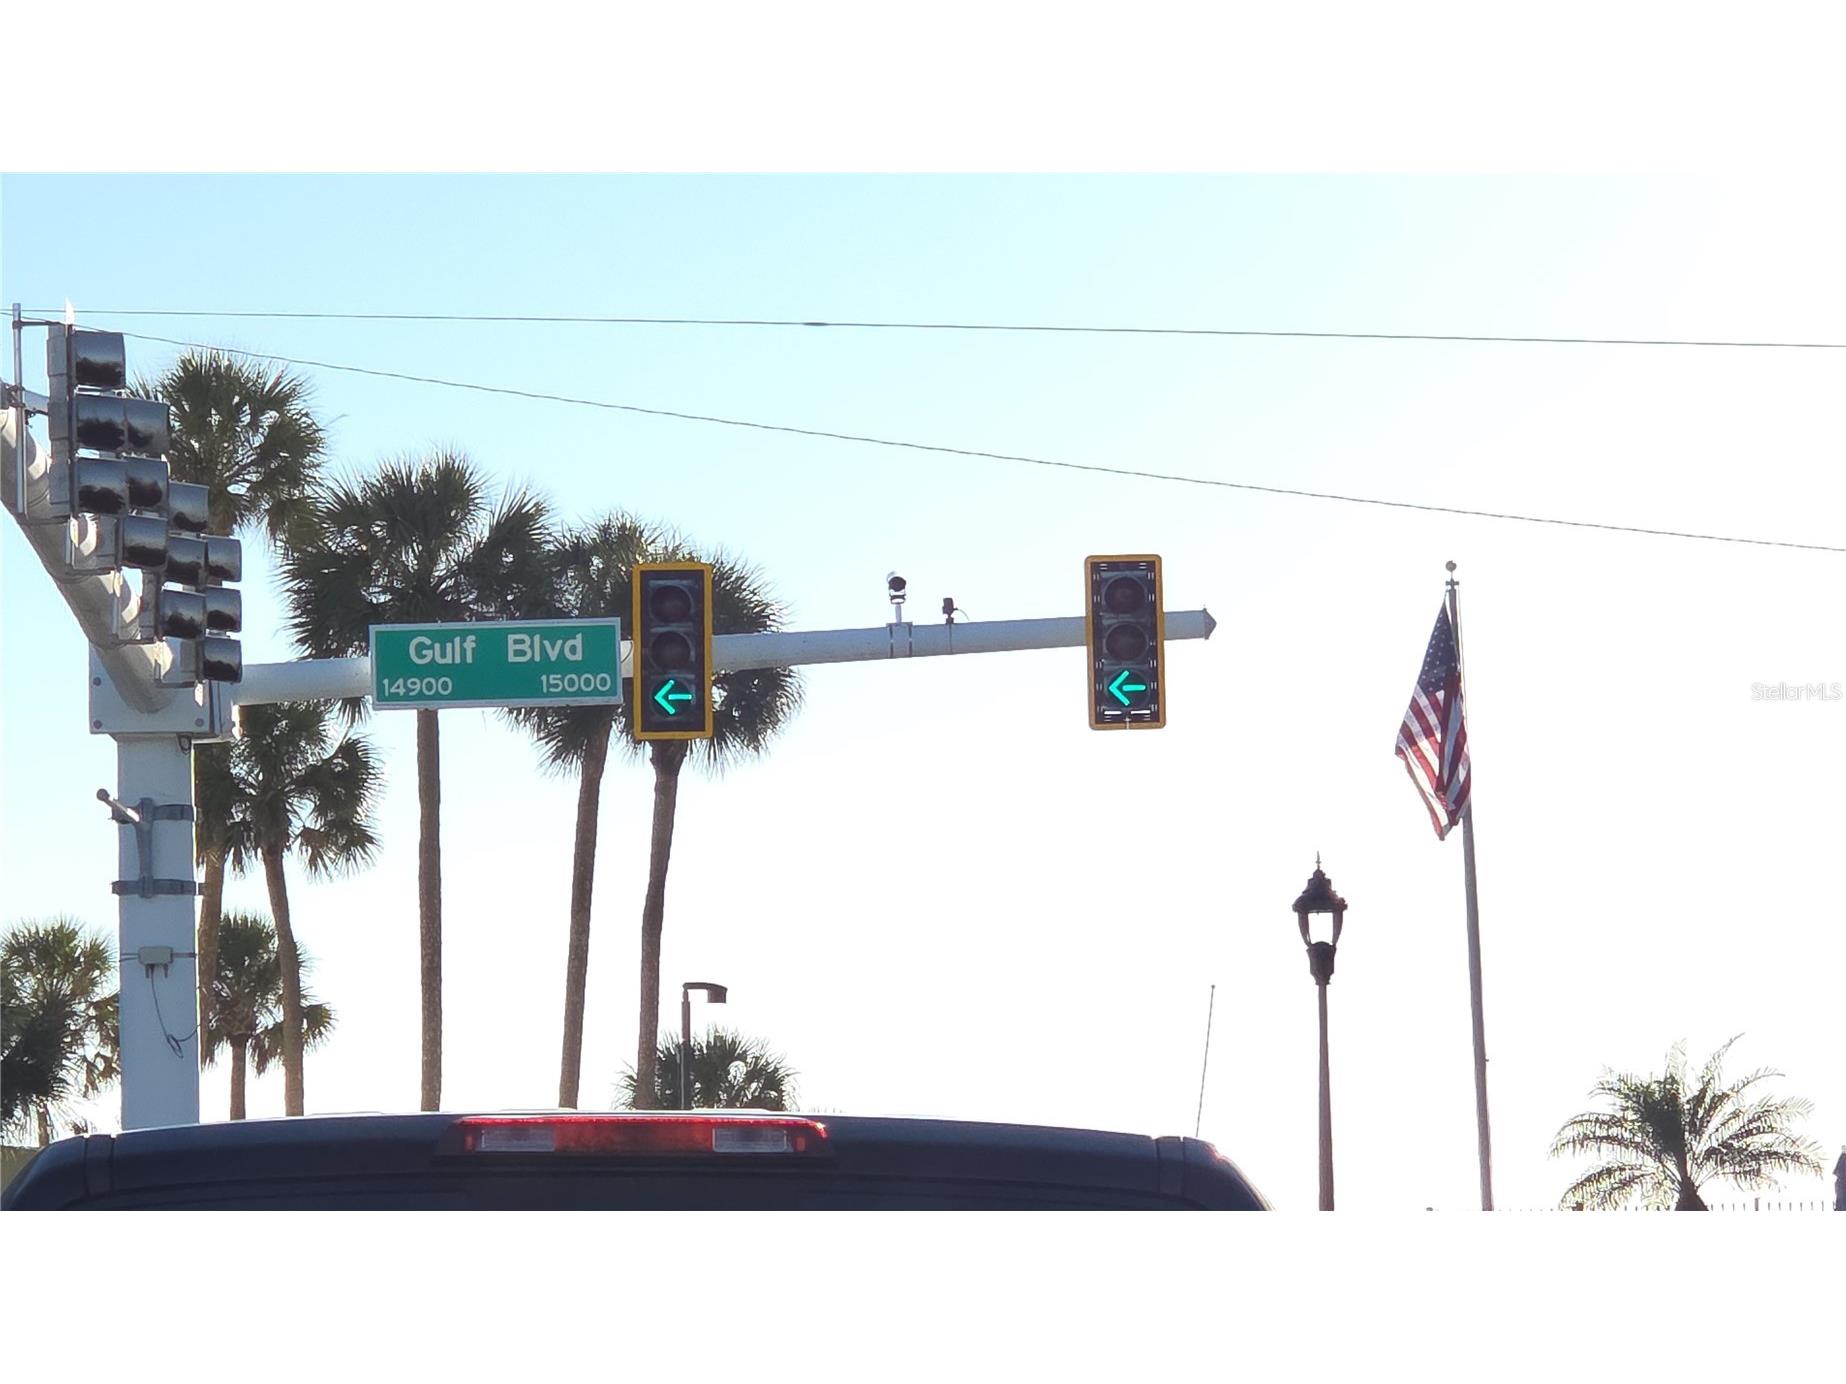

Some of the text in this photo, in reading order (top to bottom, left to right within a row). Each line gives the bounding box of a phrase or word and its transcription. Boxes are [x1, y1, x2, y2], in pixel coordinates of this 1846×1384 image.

[409, 632, 583, 665] Gulf Blvd
[382, 673, 611, 696] 14900 15000
